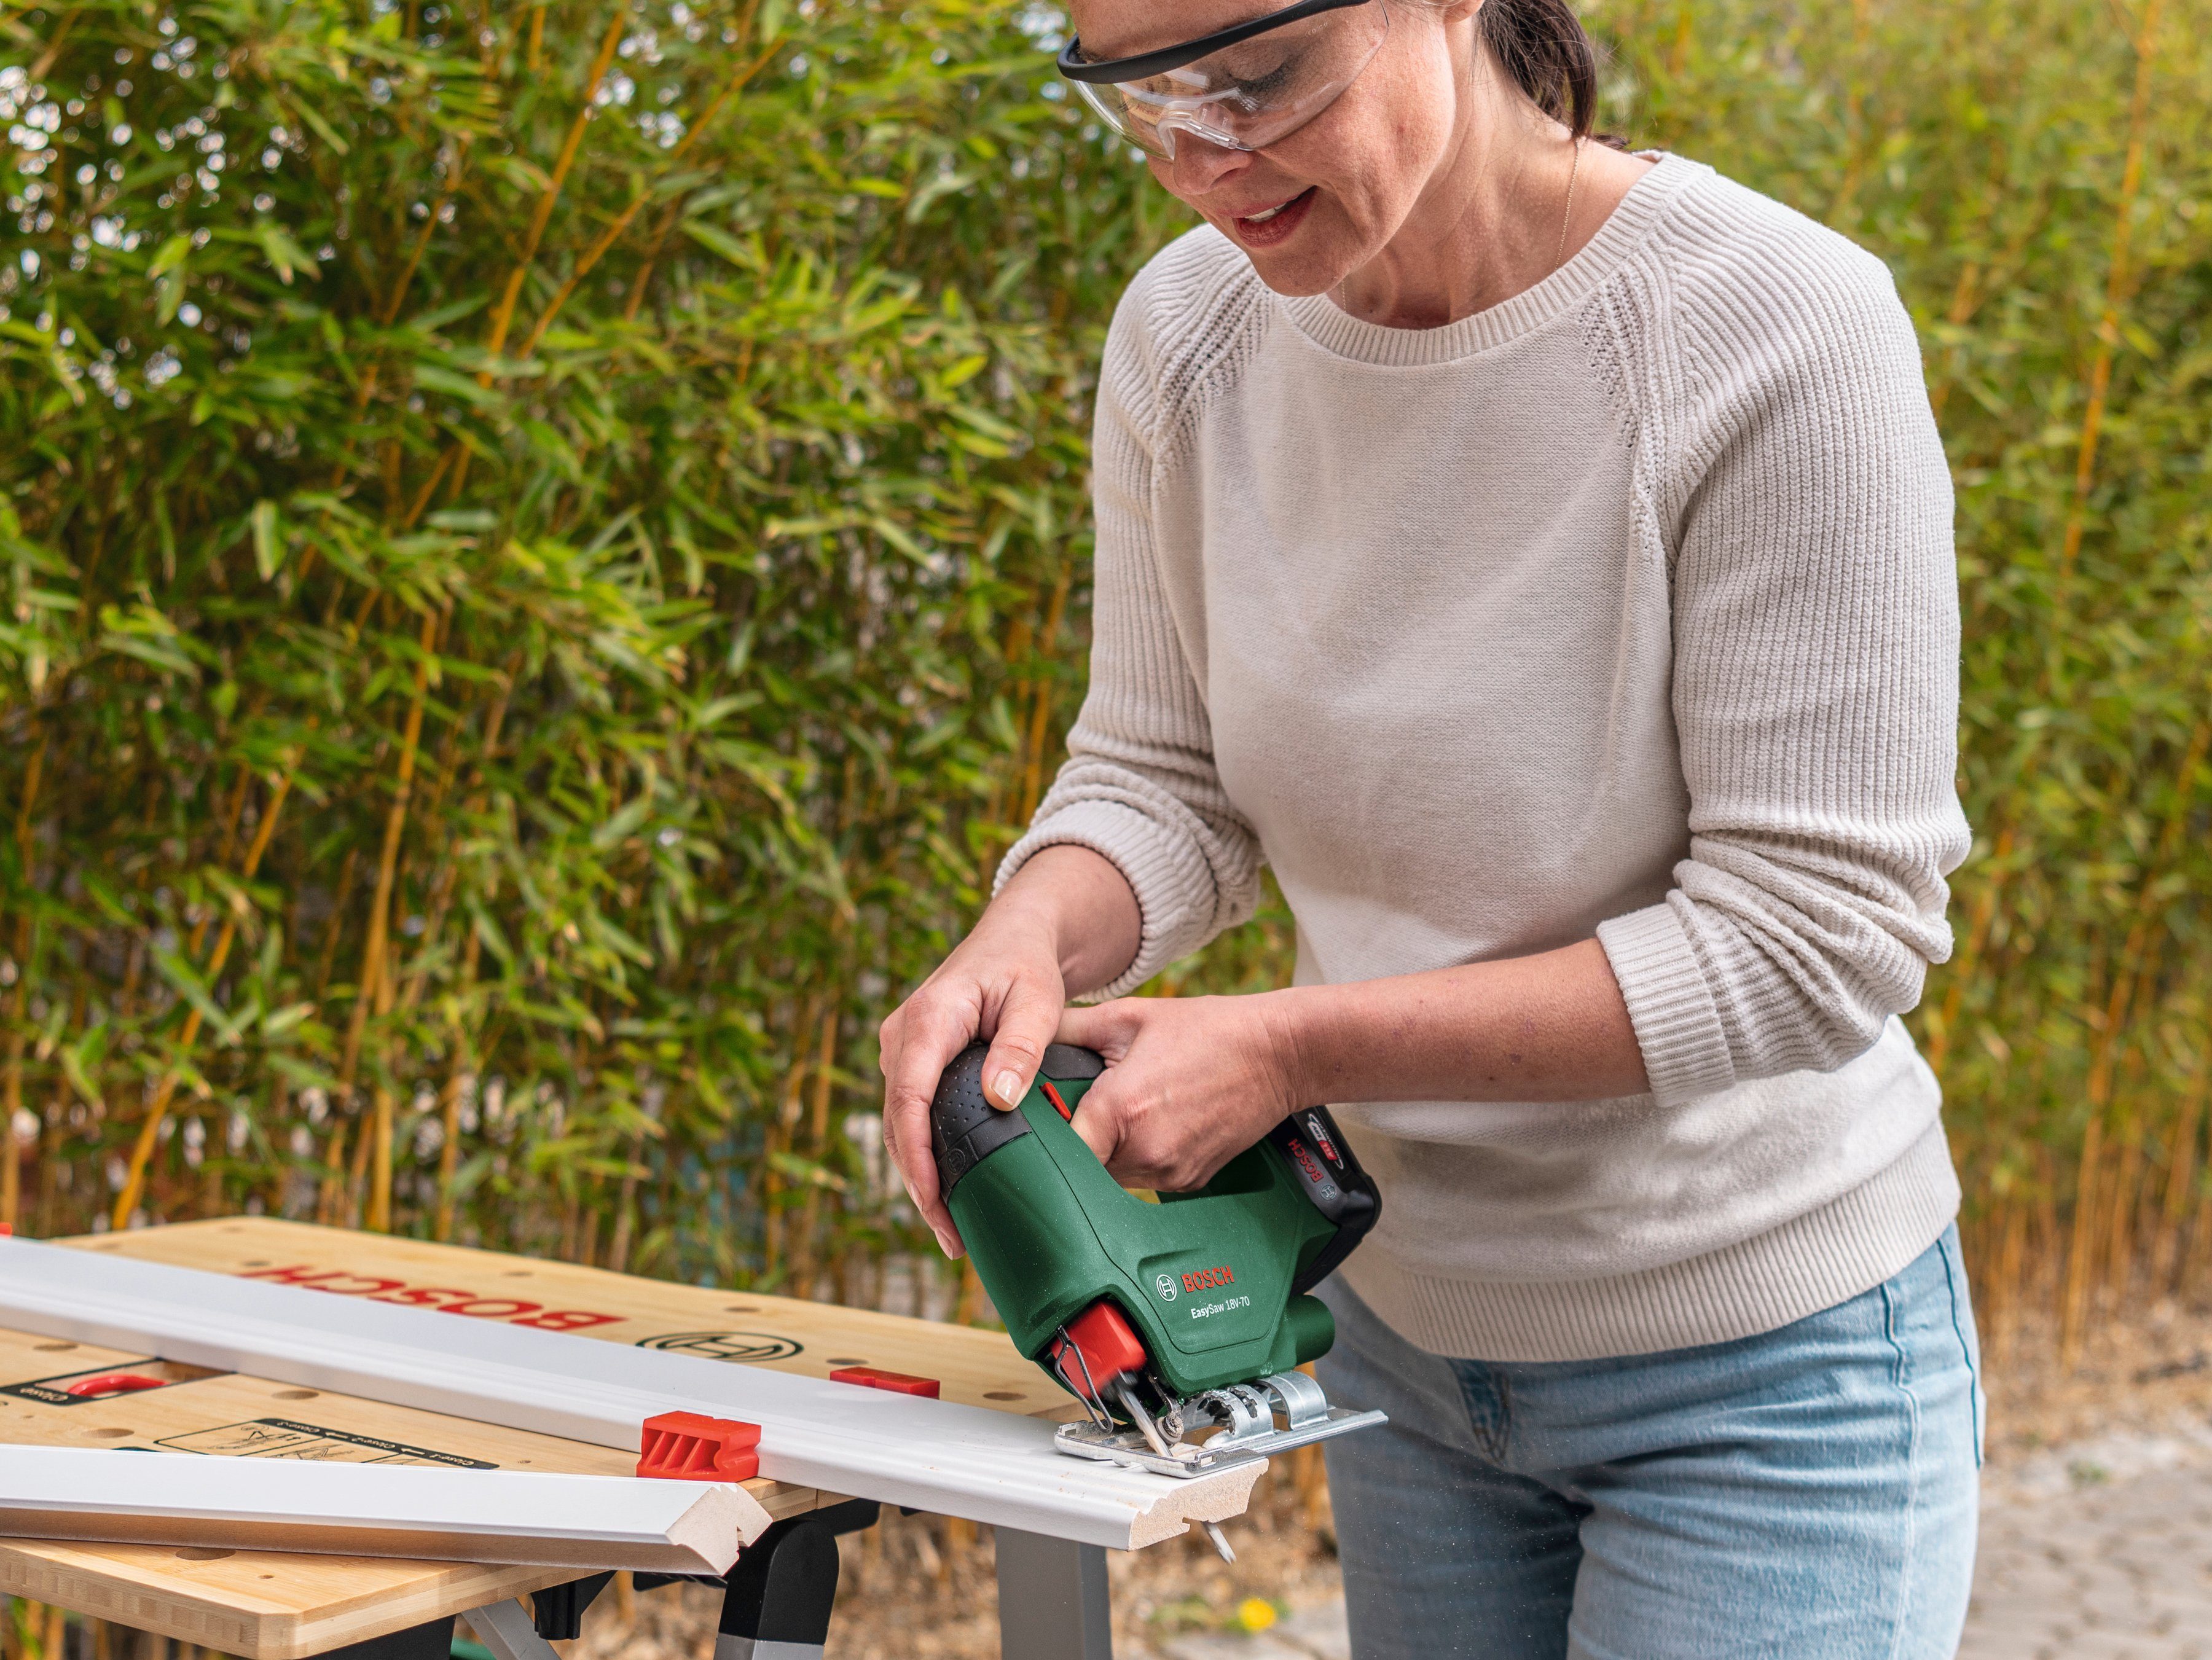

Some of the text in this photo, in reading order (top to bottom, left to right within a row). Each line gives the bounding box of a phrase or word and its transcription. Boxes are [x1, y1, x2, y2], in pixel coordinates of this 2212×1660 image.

[1288, 1138, 1324, 1183] BOSCH
[1181, 1266, 1234, 1293] BOSCH
[1191, 1296, 1250, 1319] EasySaw 18V-70
